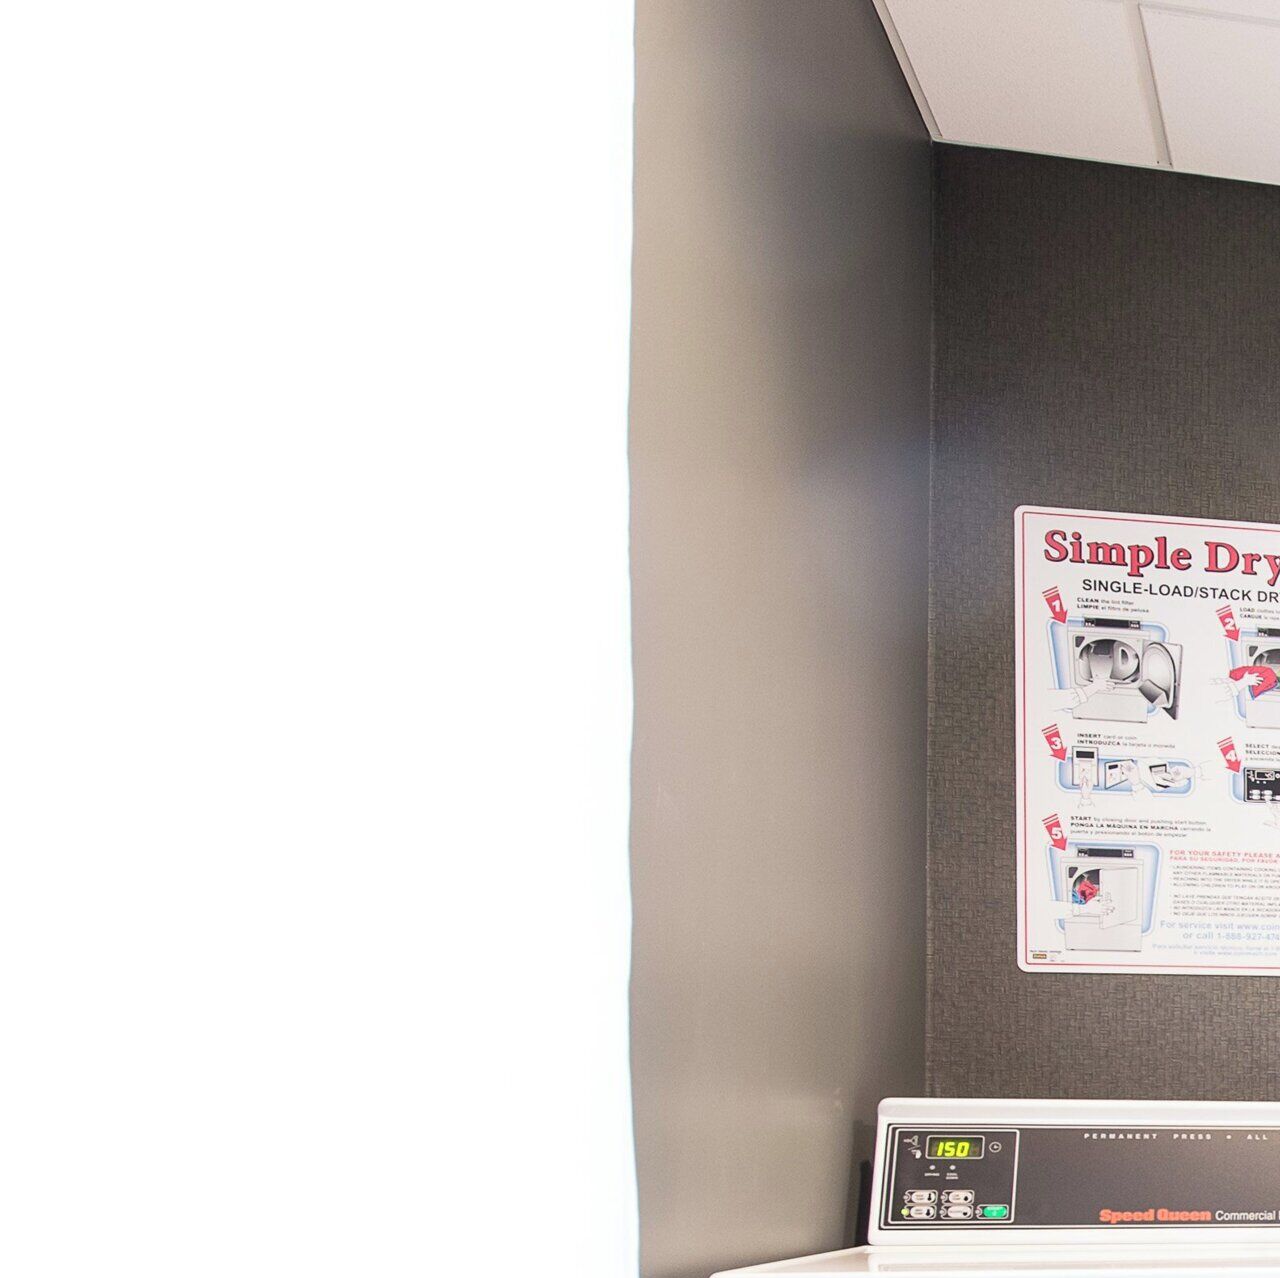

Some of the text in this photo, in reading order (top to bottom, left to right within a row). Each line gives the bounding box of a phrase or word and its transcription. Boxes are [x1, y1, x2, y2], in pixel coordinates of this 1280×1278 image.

[1044, 530, 1192, 578] Simple
[1082, 578, 1252, 602] SINGLE-LOAD/STACK
[1052, 600, 1060, 612] 1
[1076, 596, 1099, 604] CLEAN
[1224, 618, 1234, 630] 2
[1051, 738, 1062, 750] 3
[1077, 738, 1120, 746] INTRODUZCA
[1052, 828, 1062, 839] 5
[1160, 919, 1176, 928] For
[1178, 920, 1212, 929] service
[1214, 921, 1234, 930] visit
[1196, 931, 1214, 939] call
[936, 1142, 970, 1157] 150
[1099, 1209, 1155, 1224] Speed
[1157, 1208, 1212, 1222] Queen
[1215, 1210, 1276, 1221] Commercial
